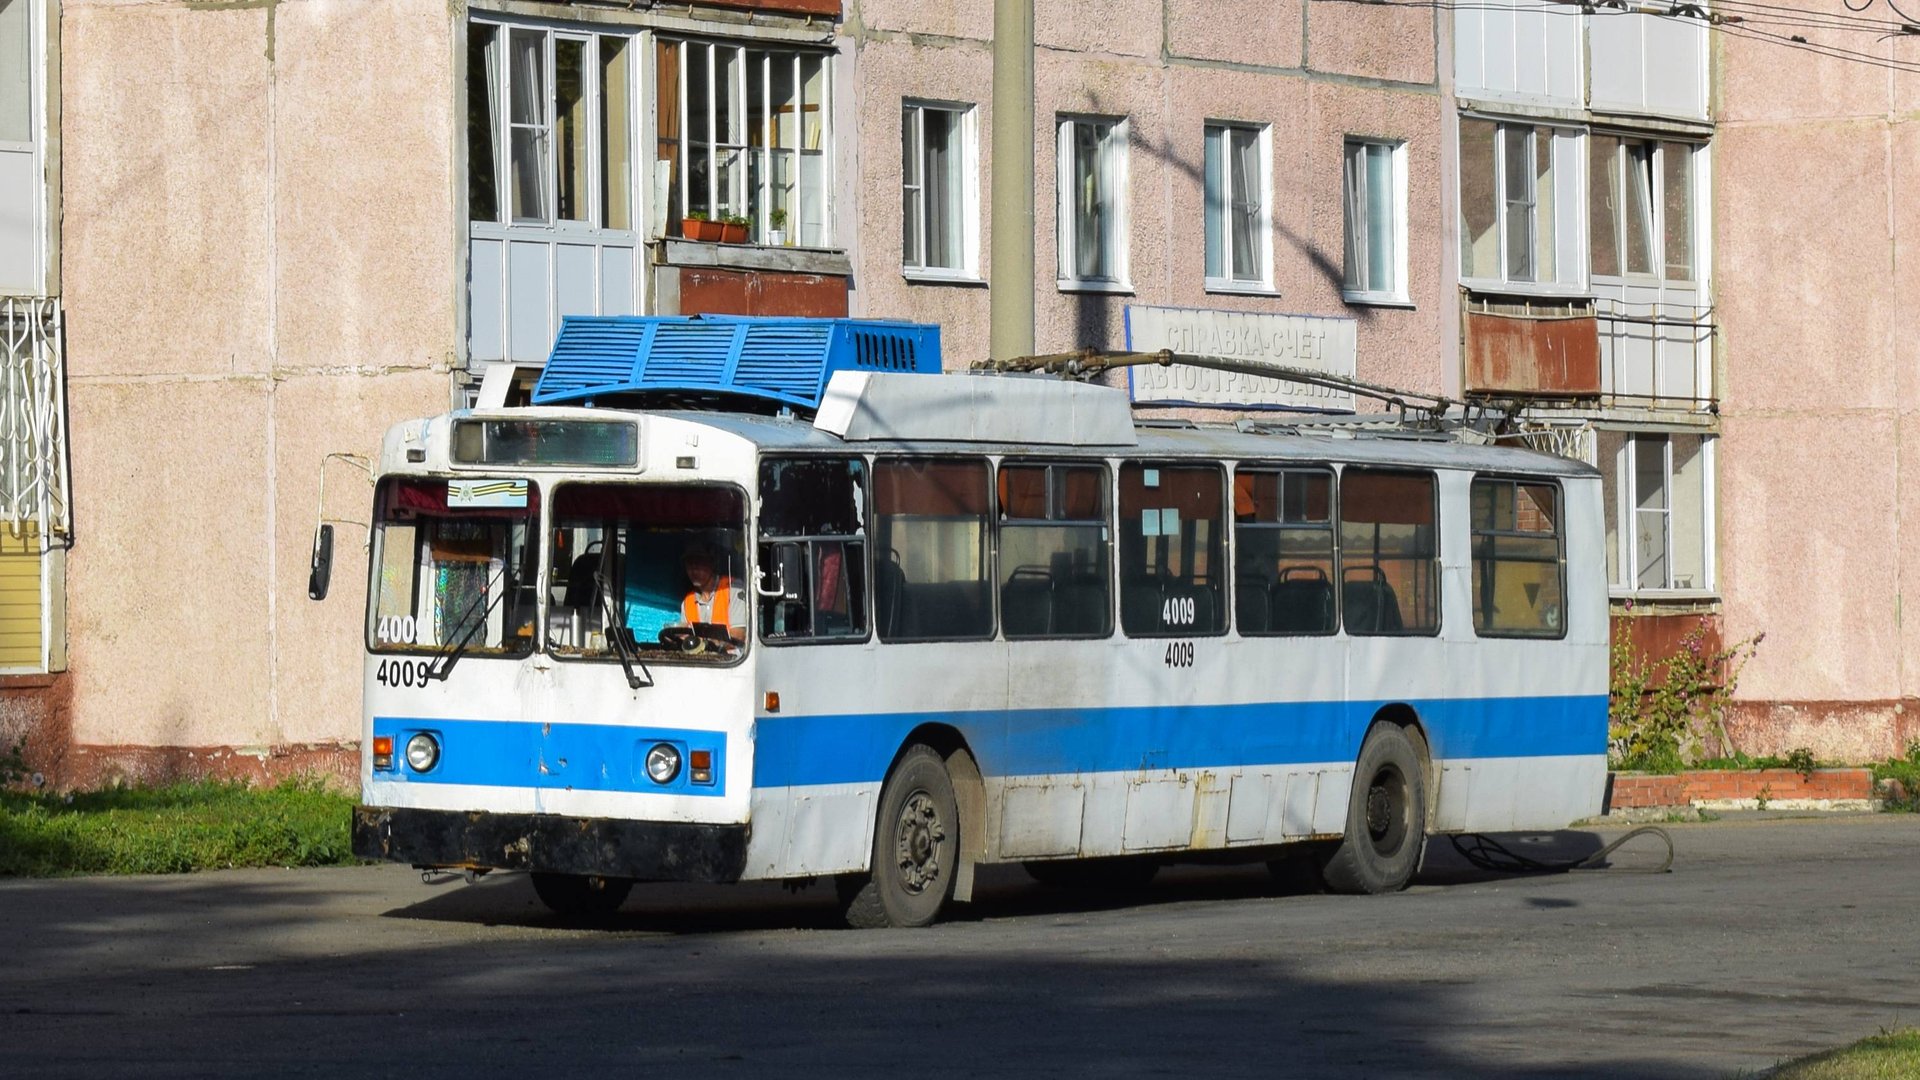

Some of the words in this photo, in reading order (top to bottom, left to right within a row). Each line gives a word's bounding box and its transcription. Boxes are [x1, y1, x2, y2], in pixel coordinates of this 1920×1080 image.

[1162, 597, 1195, 625] 4009
[378, 614, 426, 644] 400
[1164, 642, 1194, 668] 4009
[376, 658, 429, 689] 4009
